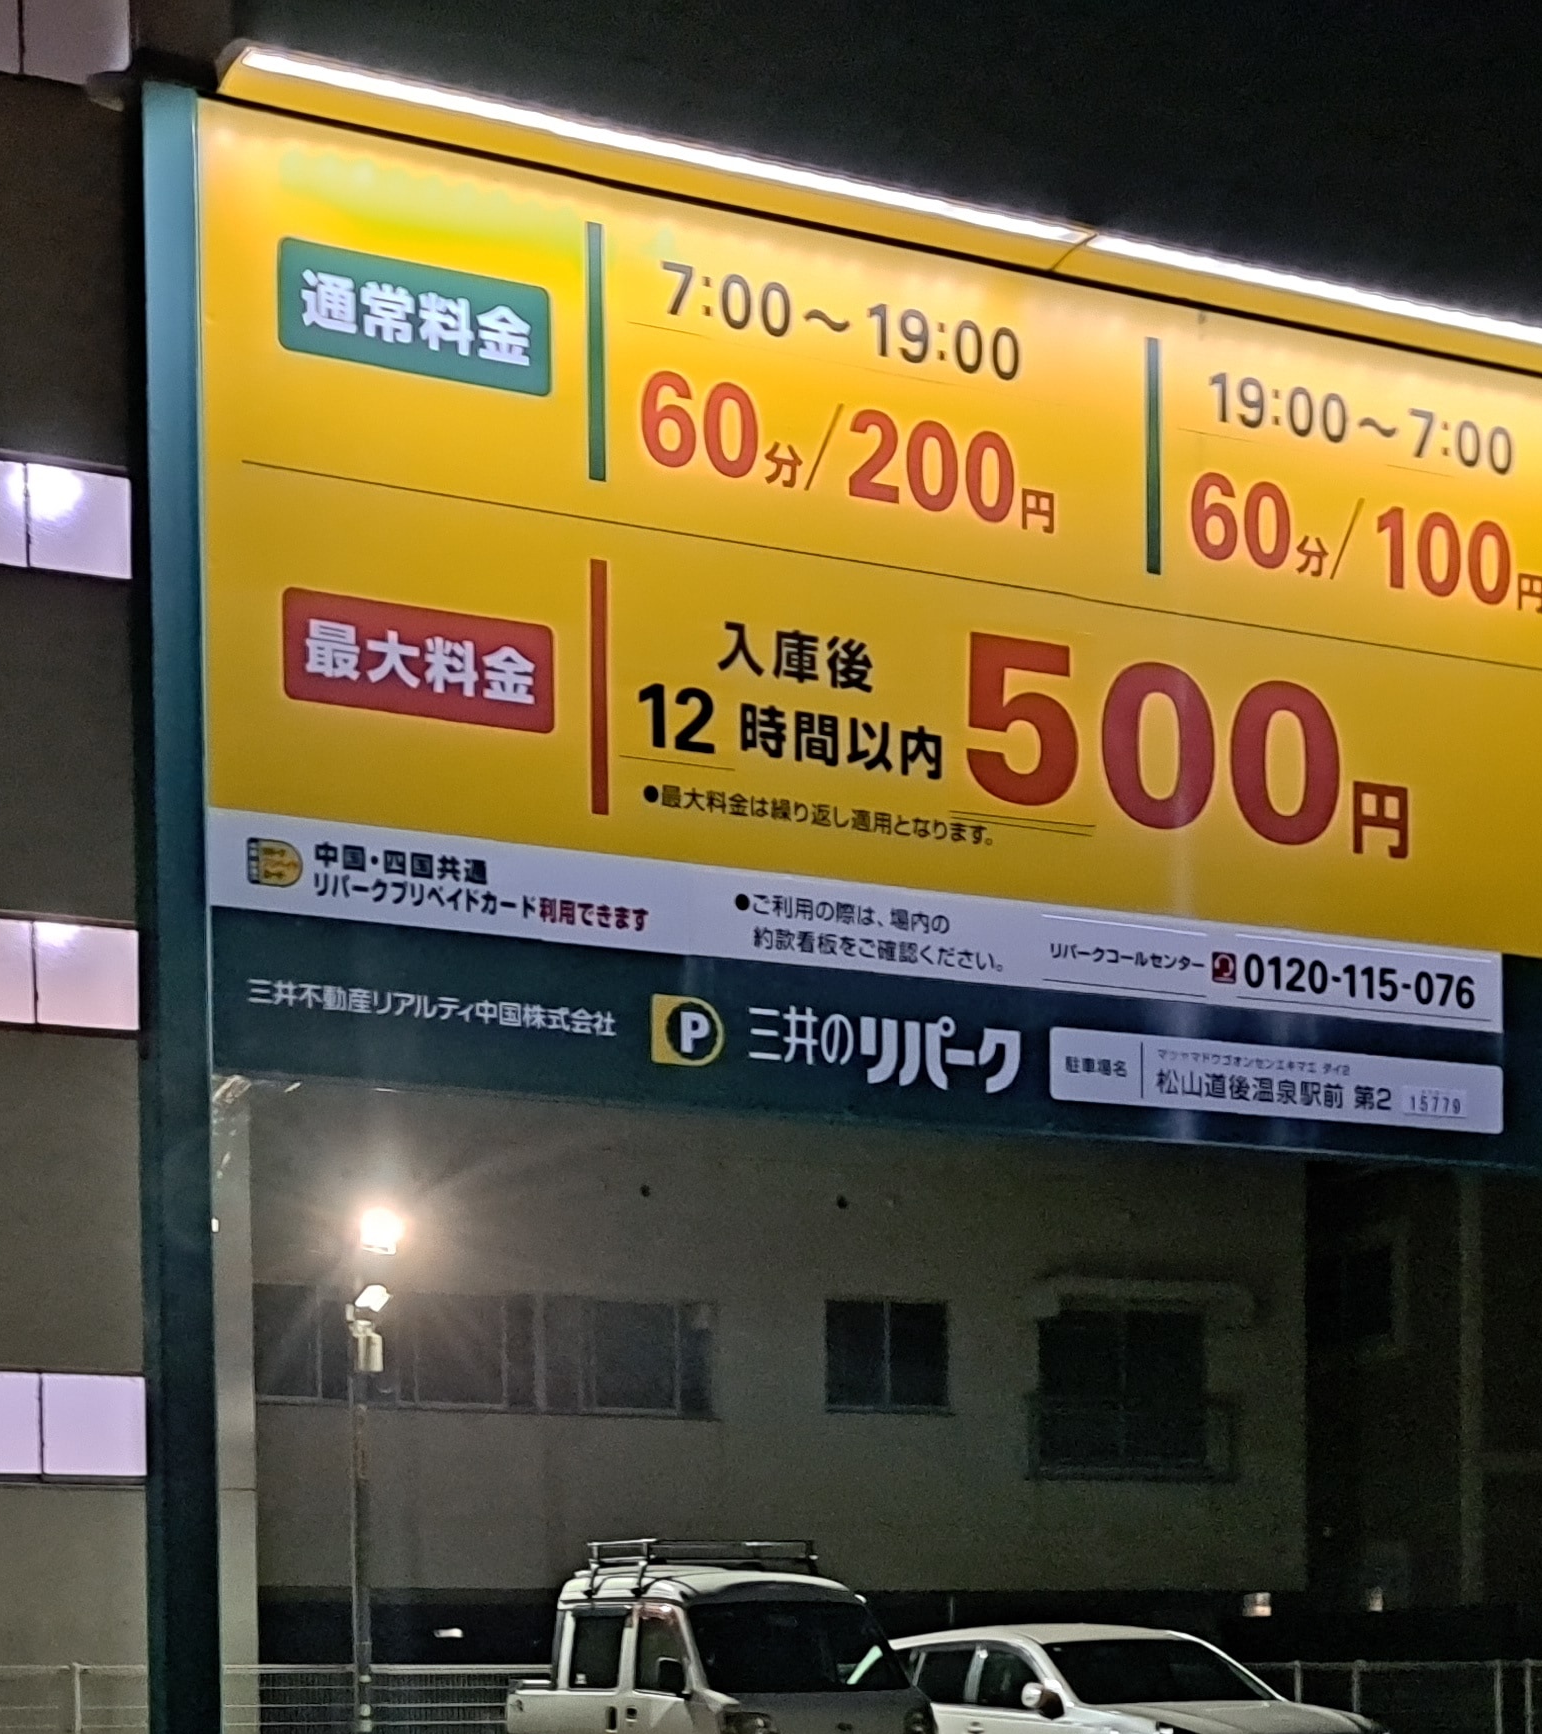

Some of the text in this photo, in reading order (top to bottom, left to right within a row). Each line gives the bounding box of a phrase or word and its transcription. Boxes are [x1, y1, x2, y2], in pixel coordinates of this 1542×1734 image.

[301, 269, 531, 367] 通常料金
[661, 261, 1021, 382] 7:00～19:00
[1208, 371, 1513, 476] 19:00～7:00
[304, 619, 536, 705] 最大料金
[717, 621, 874, 694] 入庫後
[638, 683, 943, 780] 12 時間以内
[965, 631, 1409, 861] 500円
[661, 784, 994, 847] 最大料金は繰り返し適用となります。
[313, 841, 489, 886] 中国・四国共通
[752, 893, 951, 935] ご利用の際は、場内の
[753, 926, 1004, 973] 約款看板をご確認ください。
[1243, 952, 1476, 1010] 0120-115-076
[246, 977, 618, 1038] 三井不動産リアルティ中国株式会社
[747, 1004, 1022, 1095] 三井のリパーク
[1064, 1055, 1129, 1079] 駐車場名
[1155, 1068, 1393, 1111] 松山道後温泉駅前 第2
